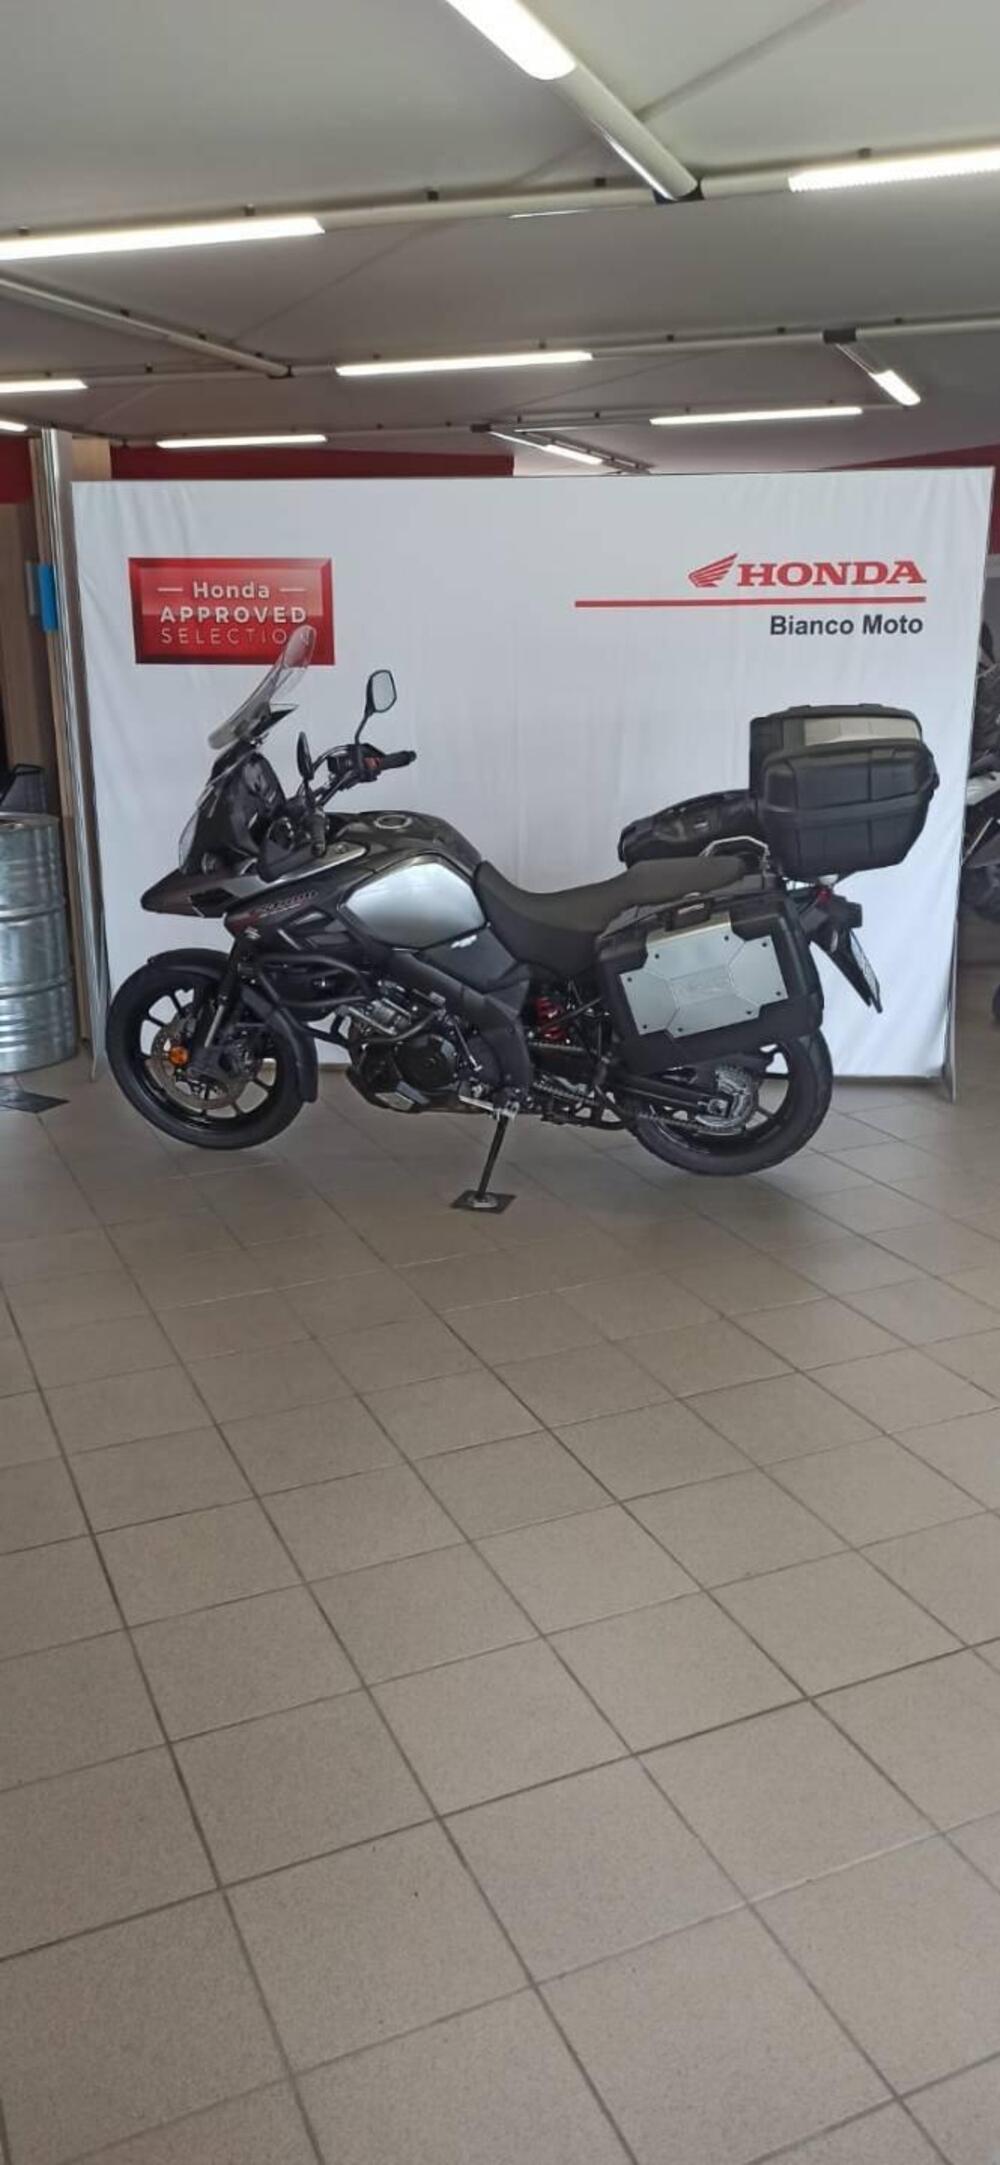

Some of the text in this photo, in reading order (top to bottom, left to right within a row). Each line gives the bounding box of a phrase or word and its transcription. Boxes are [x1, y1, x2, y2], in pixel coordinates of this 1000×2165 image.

[737, 561, 926, 587] HONDA
[193, 582, 270, 598] Honda
[160, 606, 306, 623] APPROVED
[770, 614, 923, 635] Bianco Moto
